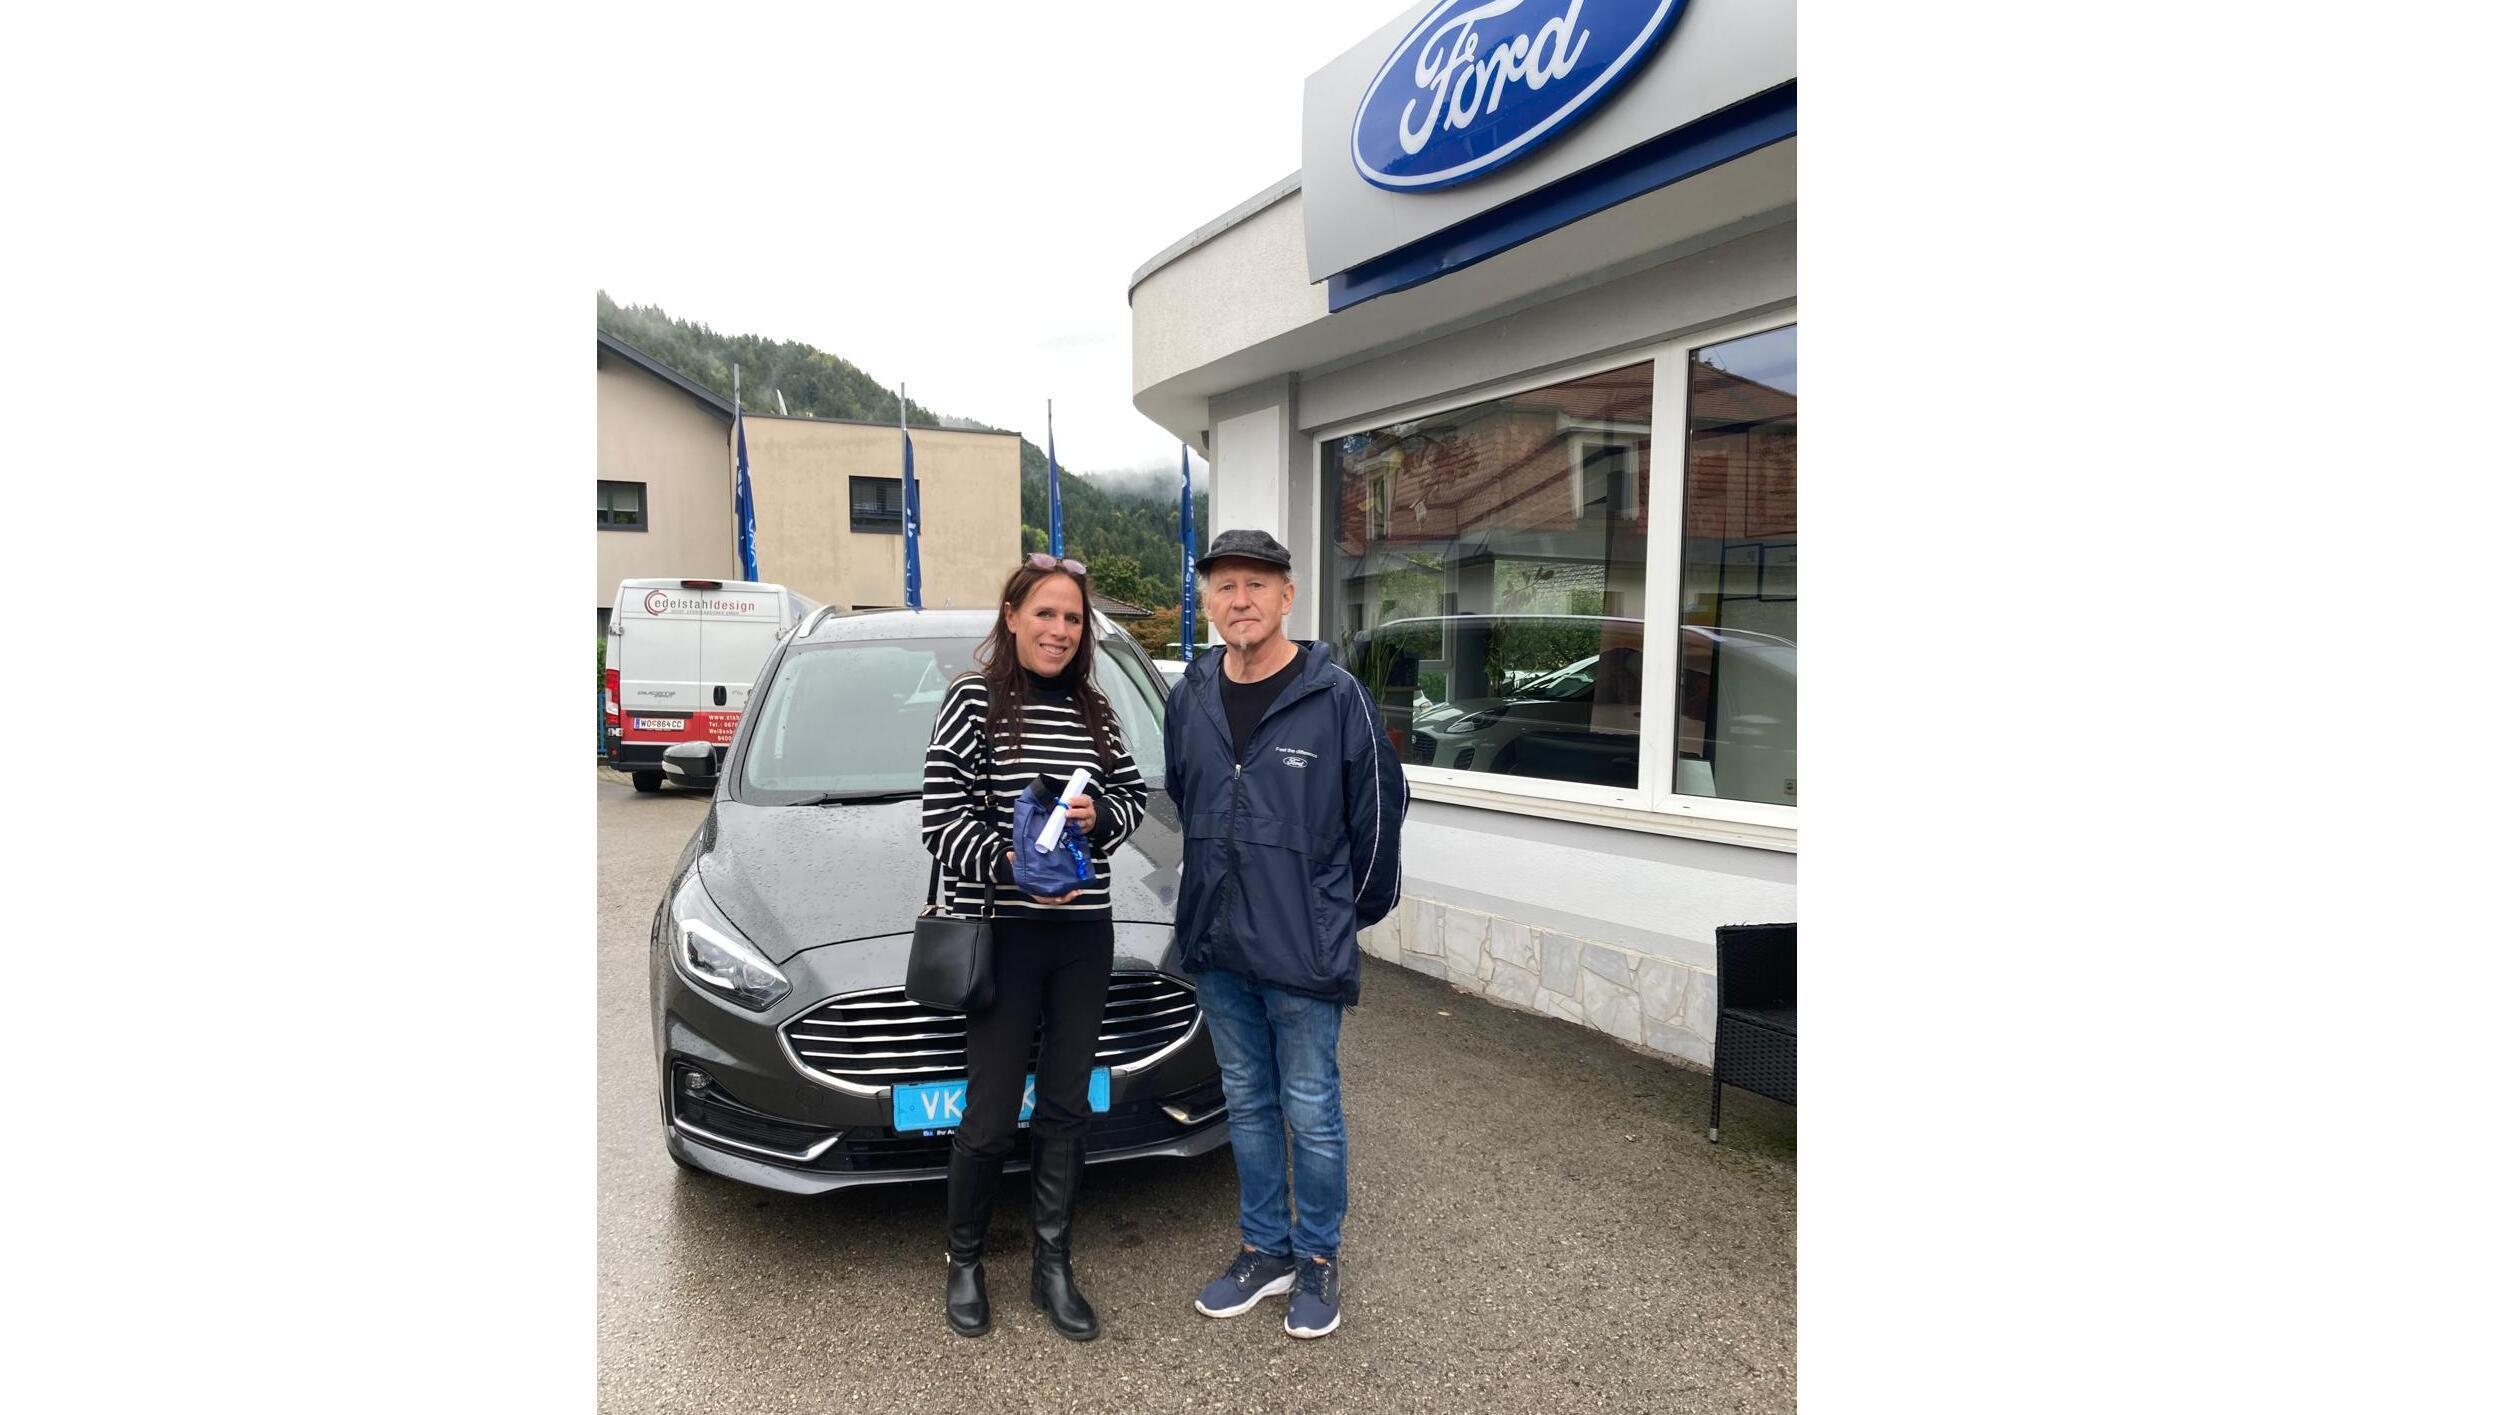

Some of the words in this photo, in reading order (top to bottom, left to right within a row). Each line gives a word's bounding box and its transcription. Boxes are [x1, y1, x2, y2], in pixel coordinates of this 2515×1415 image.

[1399, 0, 1590, 155] Ford
[654, 598, 755, 613] edelstahldesign
[921, 1088, 963, 1121] VK
